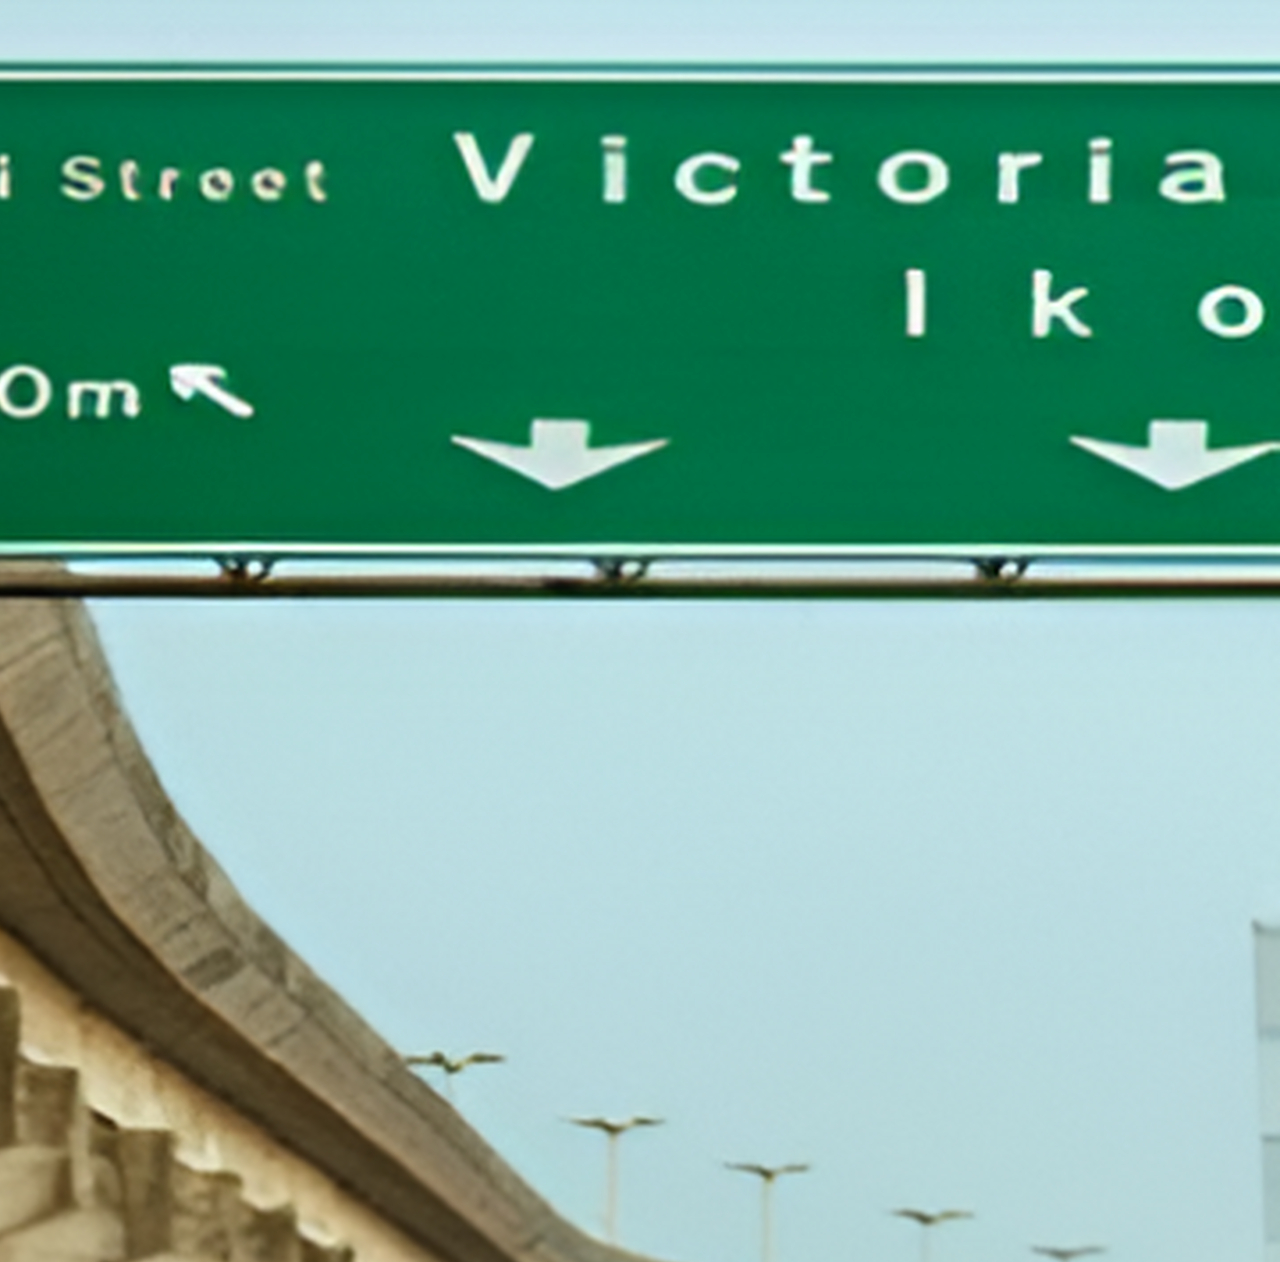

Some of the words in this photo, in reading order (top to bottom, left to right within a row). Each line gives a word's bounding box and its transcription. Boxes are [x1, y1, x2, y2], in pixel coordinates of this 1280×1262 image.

[59, 154, 328, 201] Street
[453, 131, 1226, 204] Victoria
[904, 267, 1266, 338] Iko
